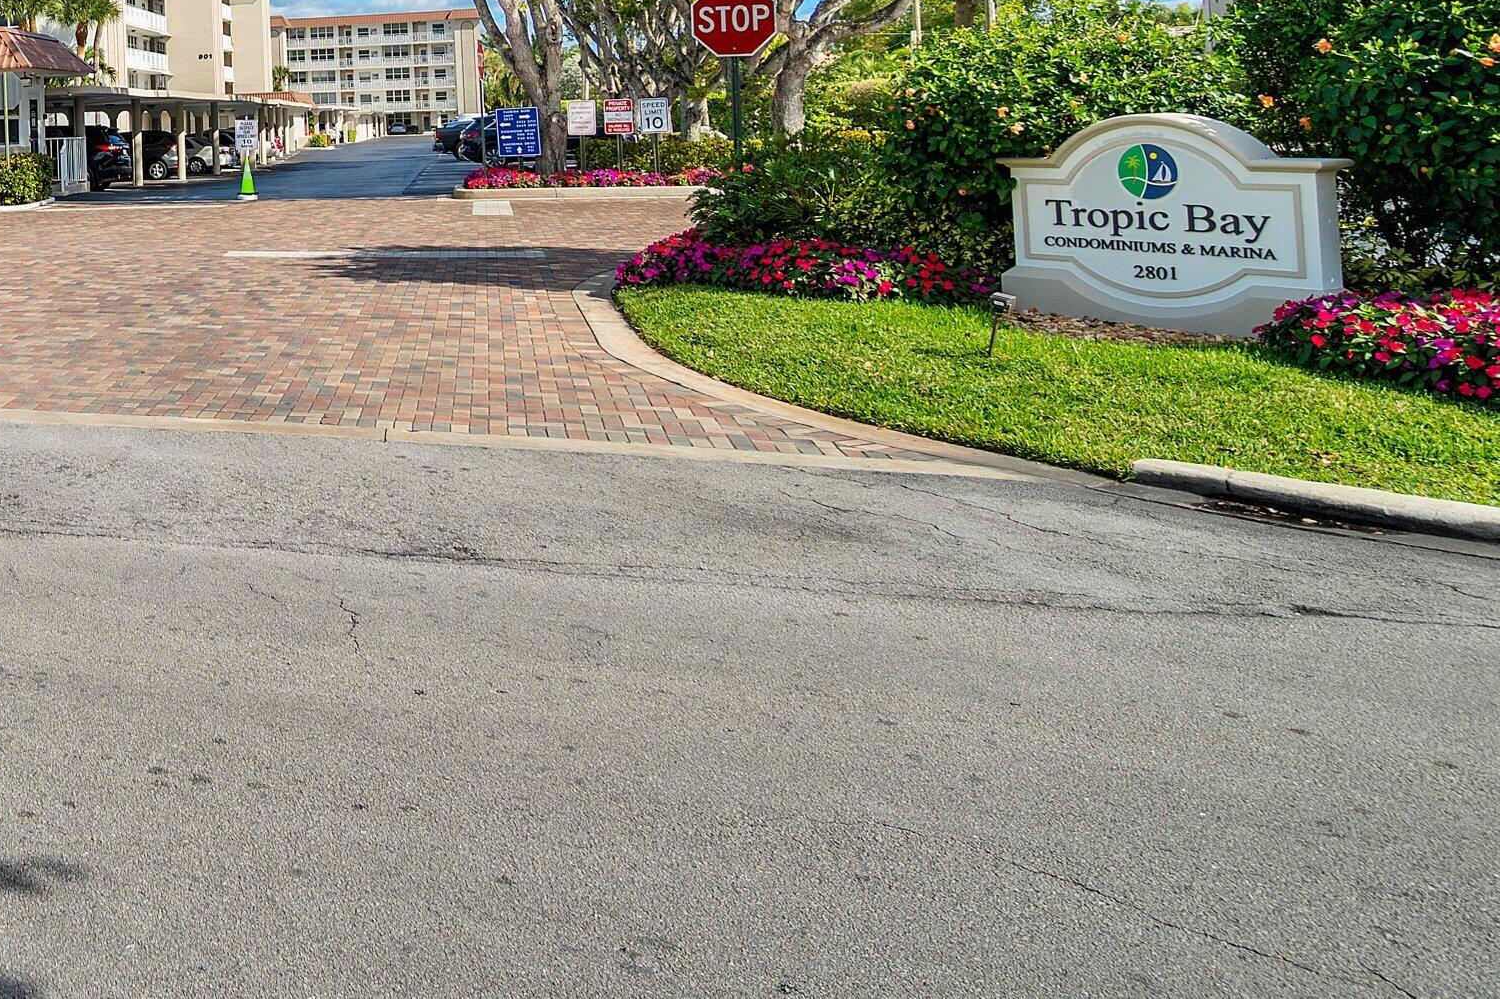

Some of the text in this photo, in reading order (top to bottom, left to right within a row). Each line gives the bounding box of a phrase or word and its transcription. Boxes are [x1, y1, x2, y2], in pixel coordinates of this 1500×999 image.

[698, 4, 770, 33] STOP
[645, 117, 663, 129] 10
[1045, 199, 1271, 243] Tropic Bay
[1044, 236, 1278, 261] CONDOMINIUMS & MARINA
[1134, 265, 1177, 280] 2801
